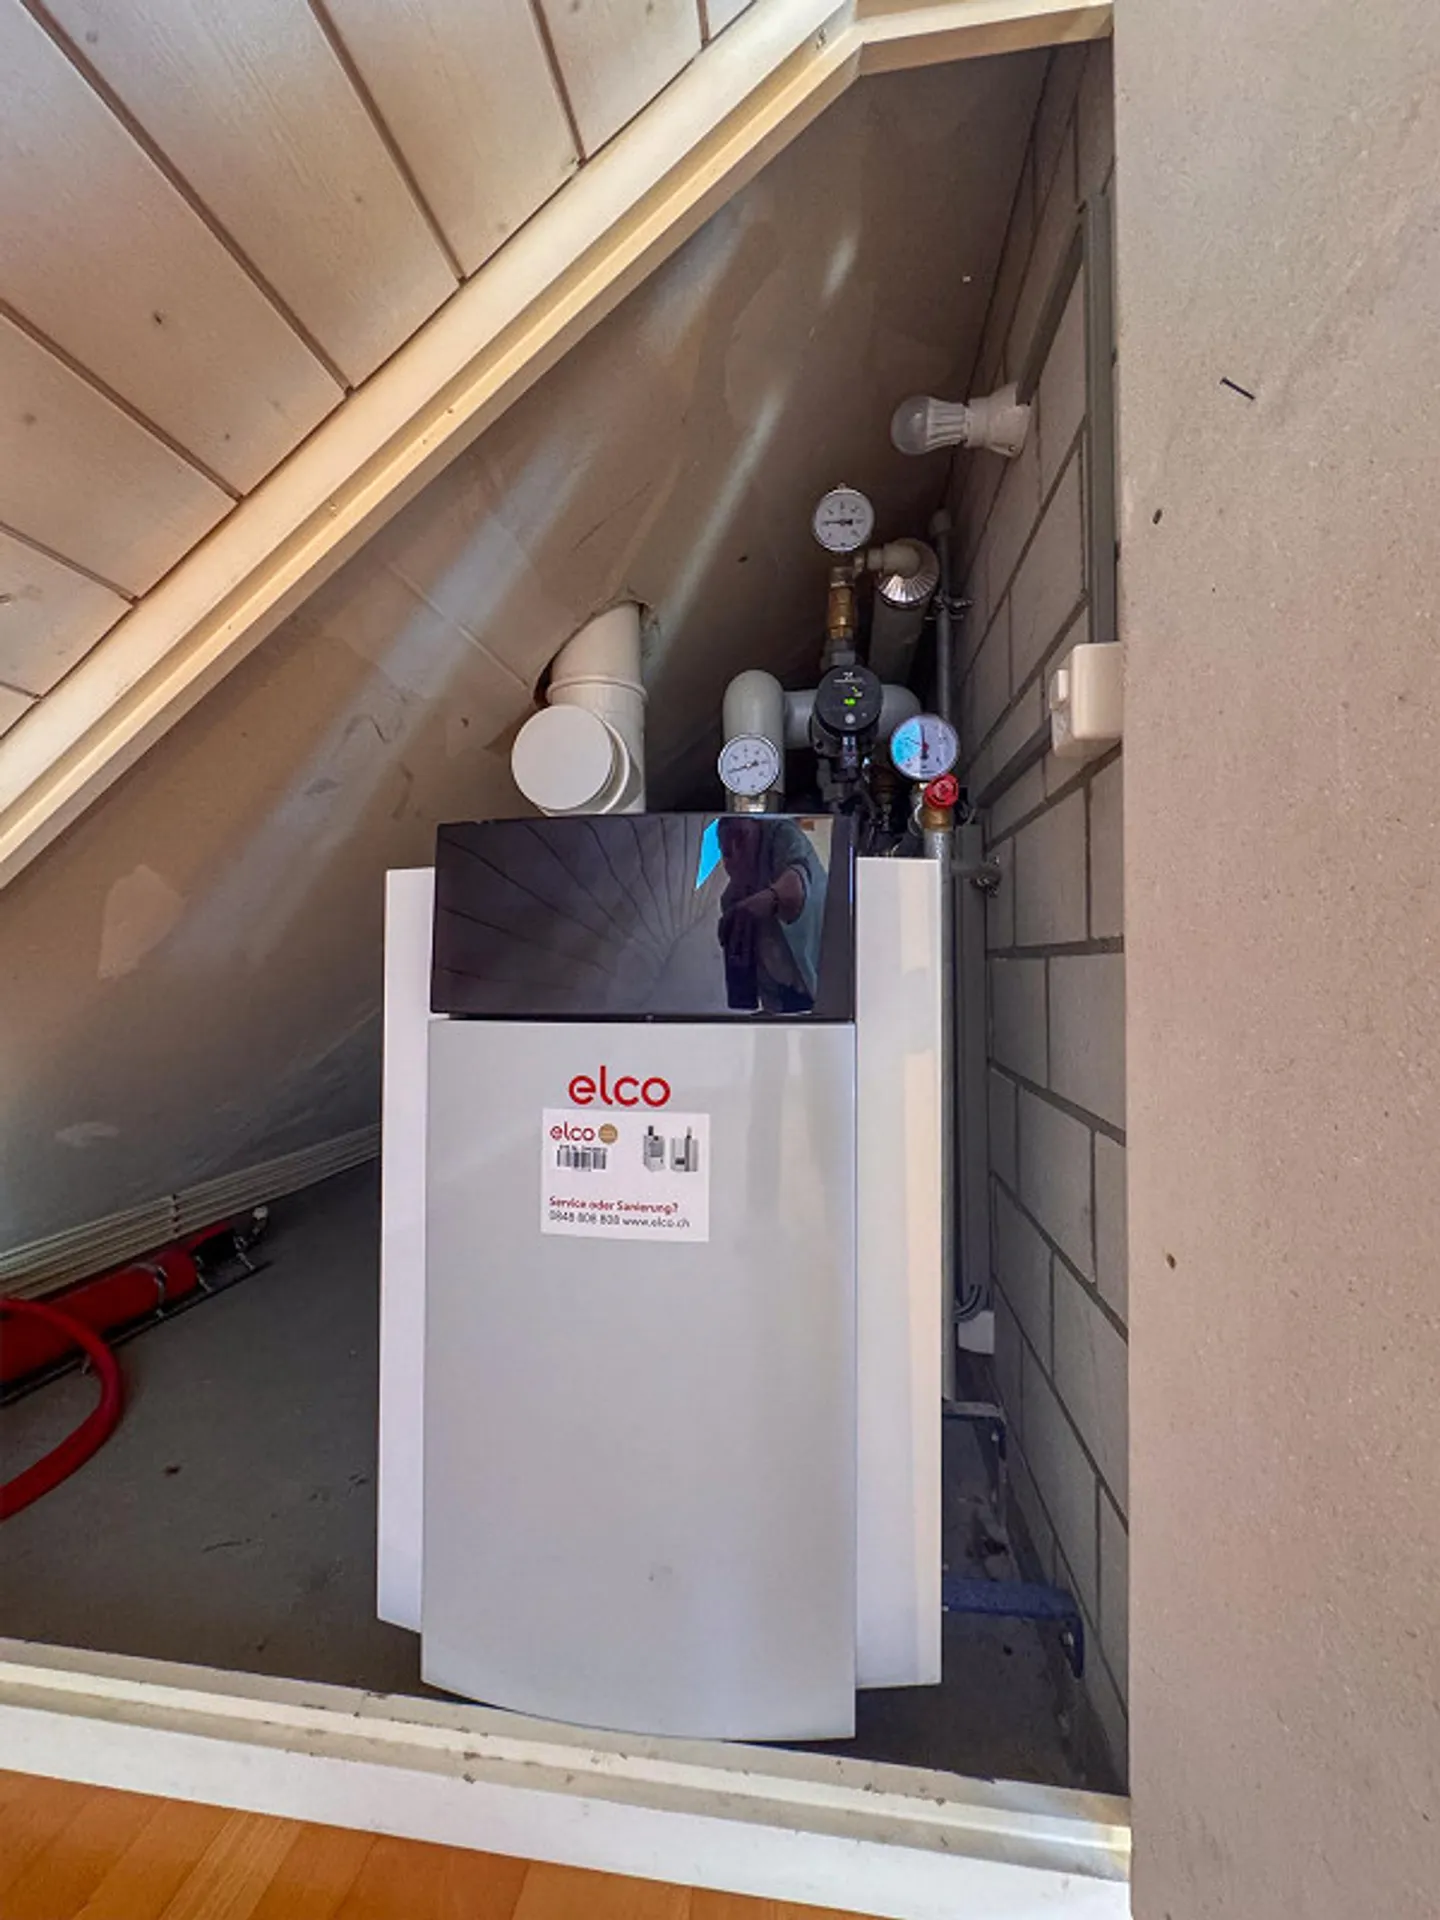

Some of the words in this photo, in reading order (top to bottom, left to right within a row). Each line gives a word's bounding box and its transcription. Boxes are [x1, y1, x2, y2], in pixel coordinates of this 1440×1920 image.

[568, 1065, 671, 1107] elco
[549, 1121, 596, 1141] elco
[549, 1196, 587, 1208] Service
[588, 1200, 614, 1211] oder
[616, 1201, 678, 1215] Sanierung?
[622, 1216, 690, 1229] www.elco.ch
